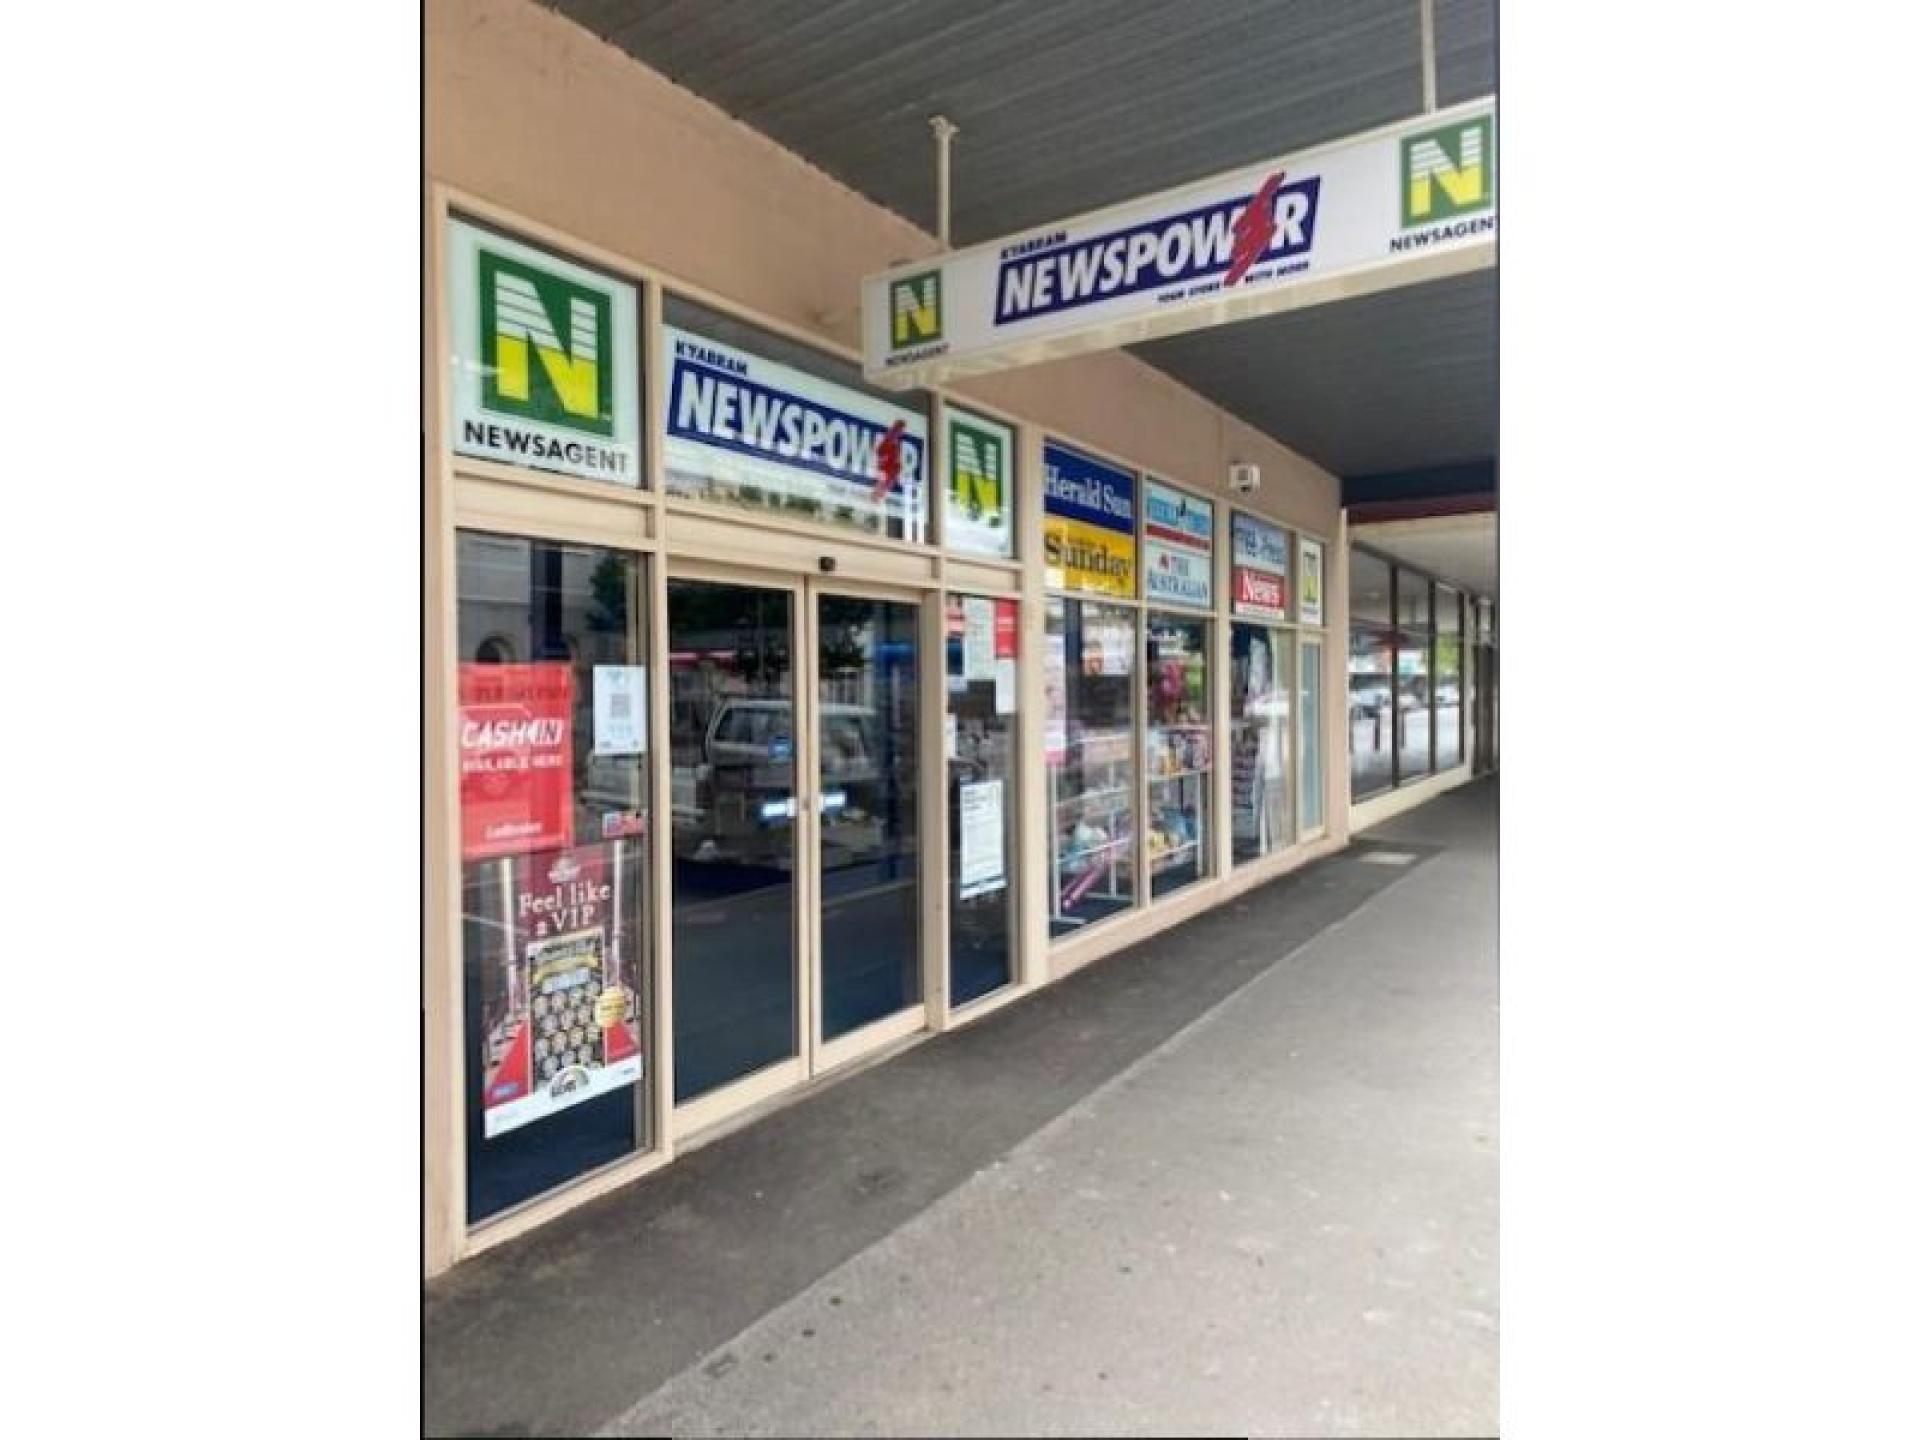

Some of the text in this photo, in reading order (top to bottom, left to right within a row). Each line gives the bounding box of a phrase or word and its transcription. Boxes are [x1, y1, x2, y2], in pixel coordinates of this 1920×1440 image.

[1410, 126, 1482, 219] N
[895, 279, 936, 341] N
[495, 270, 599, 419] N
[463, 419, 628, 474] NEWSAGENT
[1042, 464, 1104, 511] Herald
[1103, 484, 1132, 520] Sun
[1044, 530, 1131, 584] Sunday
[519, 879, 612, 918] Feel like
[551, 904, 595, 932] VIP
